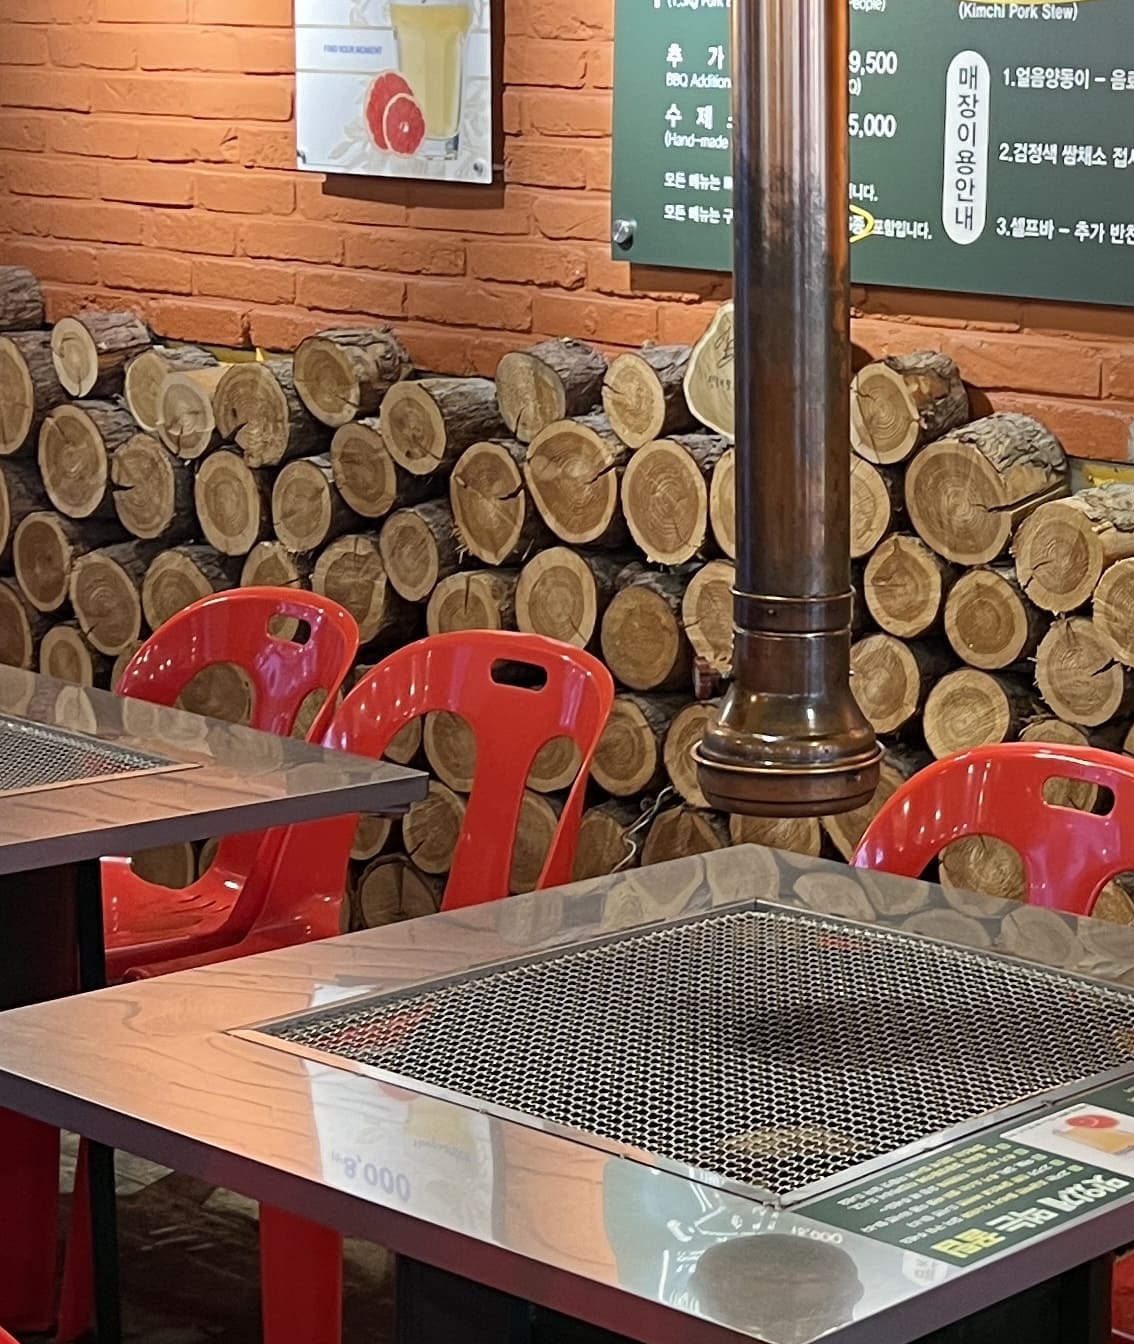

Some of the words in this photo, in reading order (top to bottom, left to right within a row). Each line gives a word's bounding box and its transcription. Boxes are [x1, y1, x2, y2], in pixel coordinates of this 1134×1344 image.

[958, 2, 1005, 21] (Kimchi
[1009, 3, 1039, 20] Pork
[1041, 1, 1079, 22] Stew)
[849, 49, 898, 76] 9,500
[665, 71, 690, 88] BBQ
[849, 112, 897, 138] 5,000
[1074, 220, 1106, 243] 추가
